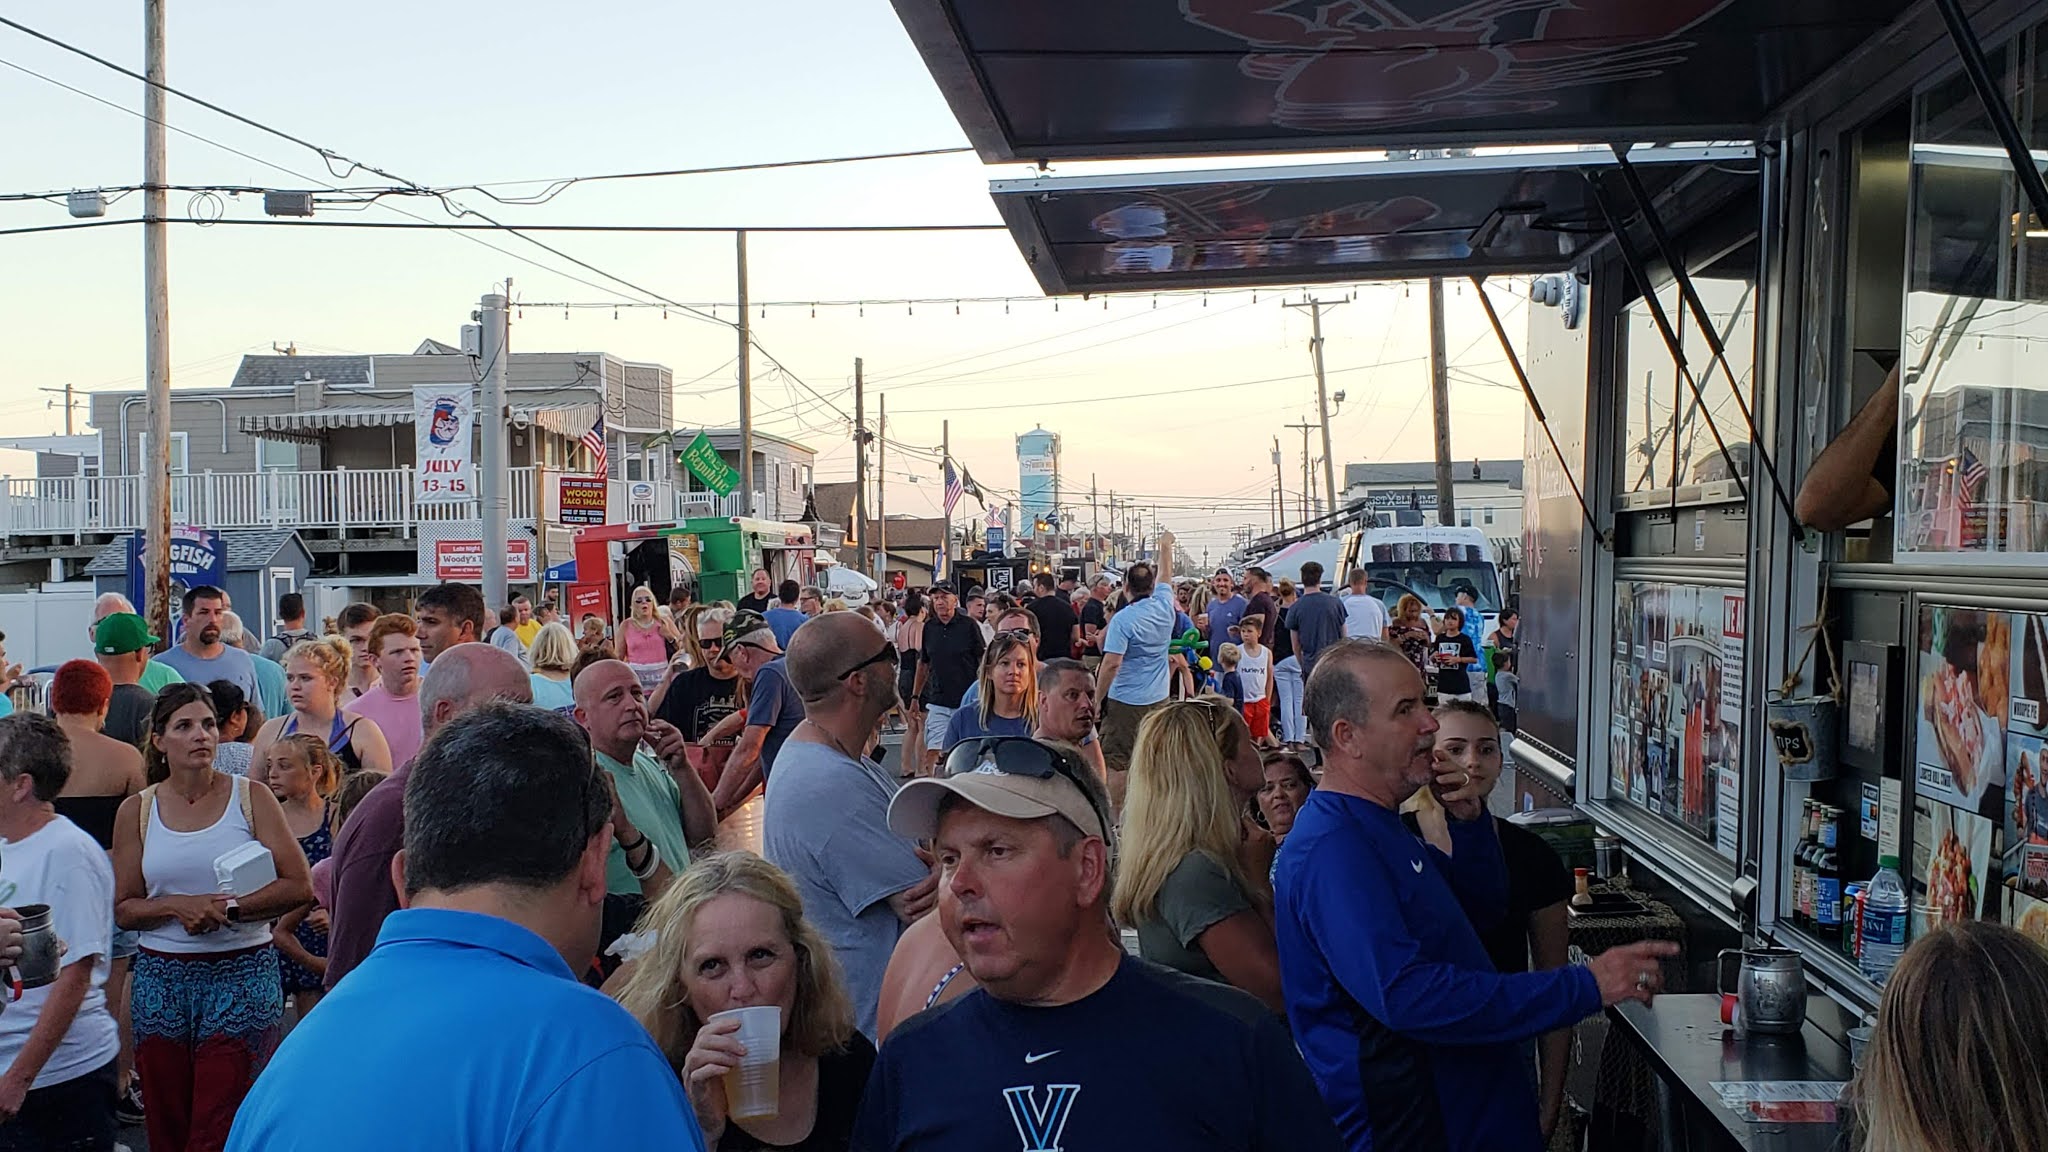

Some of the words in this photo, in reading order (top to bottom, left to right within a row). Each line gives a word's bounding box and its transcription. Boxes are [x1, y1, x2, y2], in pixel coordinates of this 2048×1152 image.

[422, 459, 462, 475] JULY
[686, 448, 730, 491] Republic
[422, 479, 466, 492] 13-15
[565, 489, 604, 498] WOODY'S
[562, 497, 582, 505] TACO
[583, 498, 606, 506] SHACK
[443, 555, 477, 564] Woody's
[998, 569, 1010, 596] PIRAT
[1776, 735, 1800, 750] TIPS
[1002, 1084, 1081, 1152] V
